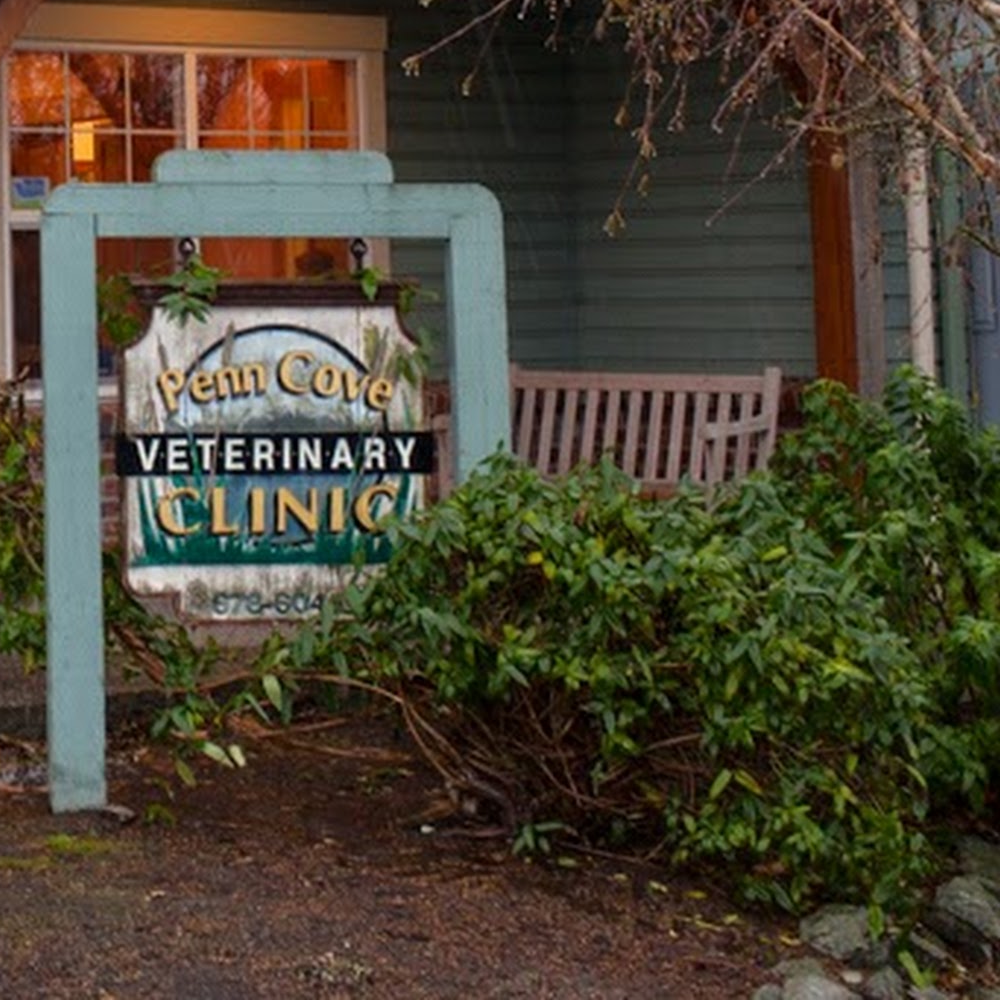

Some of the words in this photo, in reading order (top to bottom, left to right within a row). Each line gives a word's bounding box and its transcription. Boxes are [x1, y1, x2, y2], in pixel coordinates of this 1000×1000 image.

[157, 361, 267, 413] Penn
[277, 350, 394, 412] Cove
[136, 437, 417, 472] VETERINARY
[155, 482, 398, 538] CLINIC
[212, 592, 326, 615] 678-604
